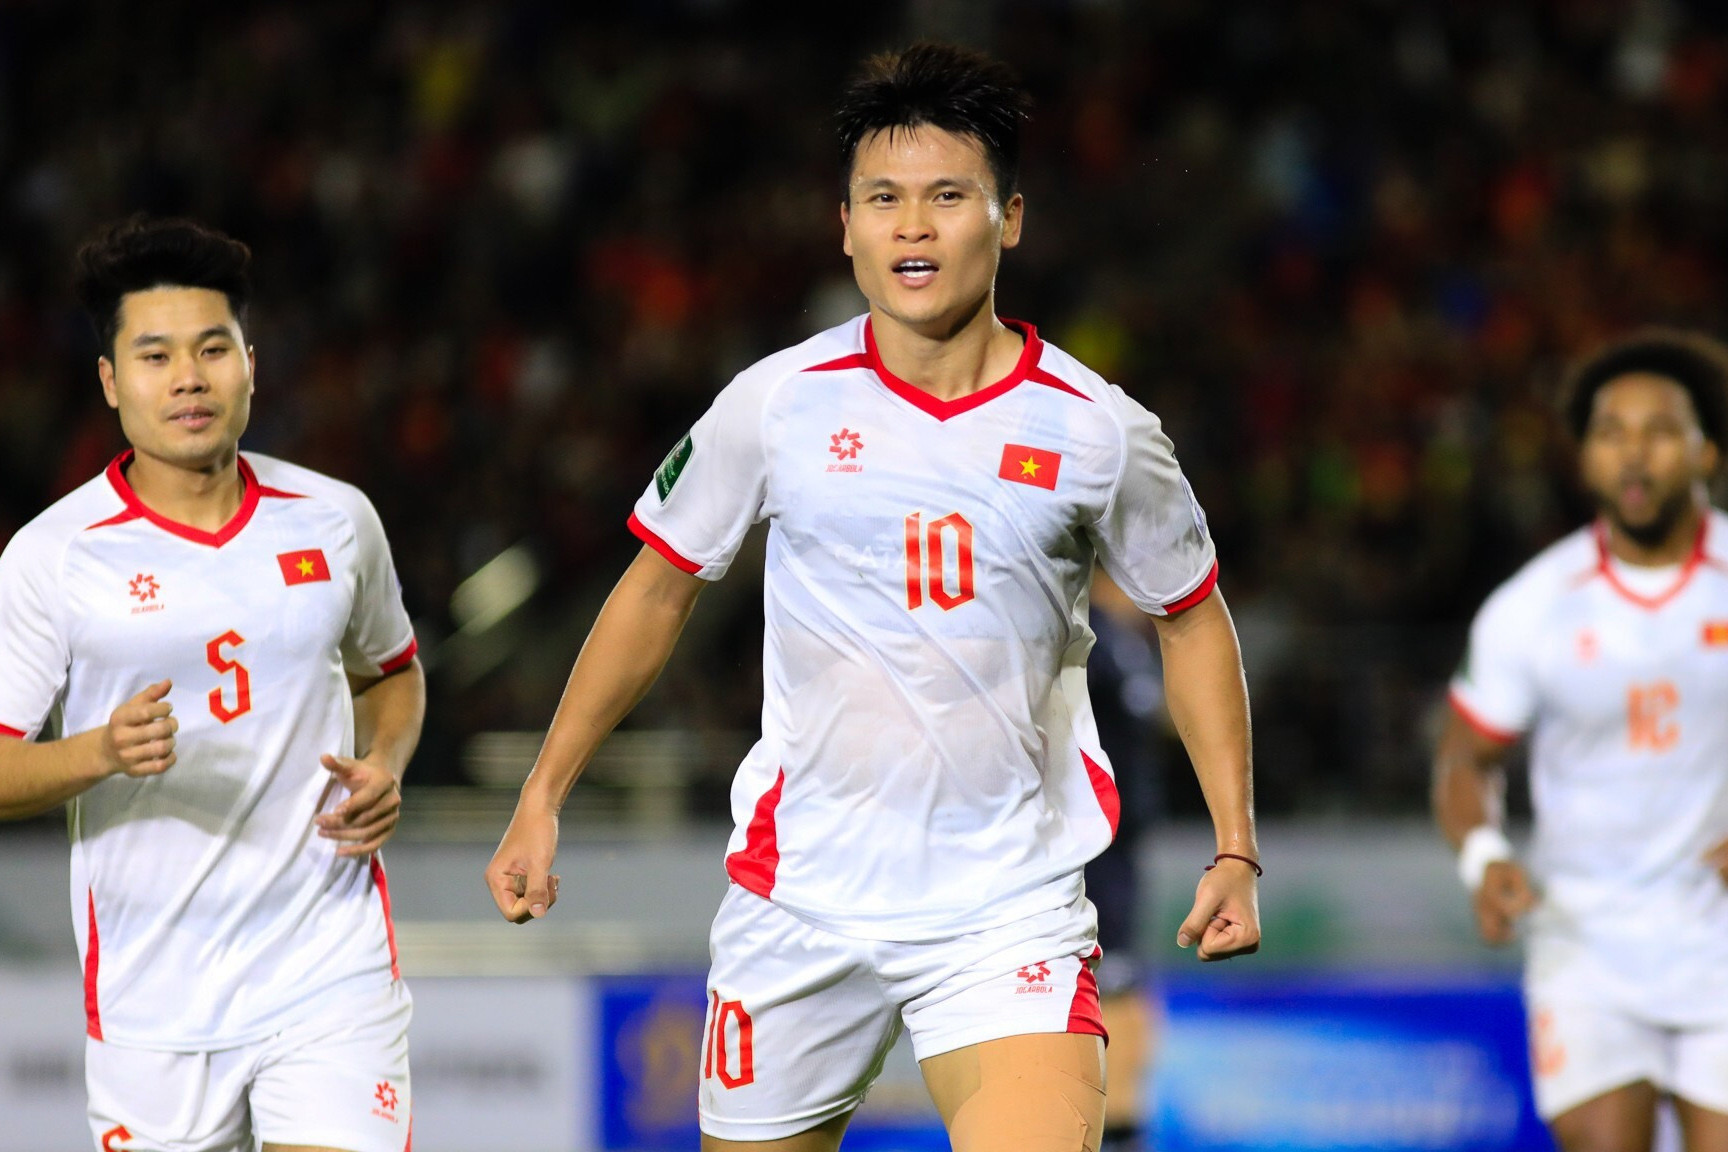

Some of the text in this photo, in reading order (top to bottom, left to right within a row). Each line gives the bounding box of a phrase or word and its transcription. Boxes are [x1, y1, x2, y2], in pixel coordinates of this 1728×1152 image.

[904, 511, 975, 611] 10
[206, 629, 251, 724] 5
[704, 989, 755, 1090] 10
